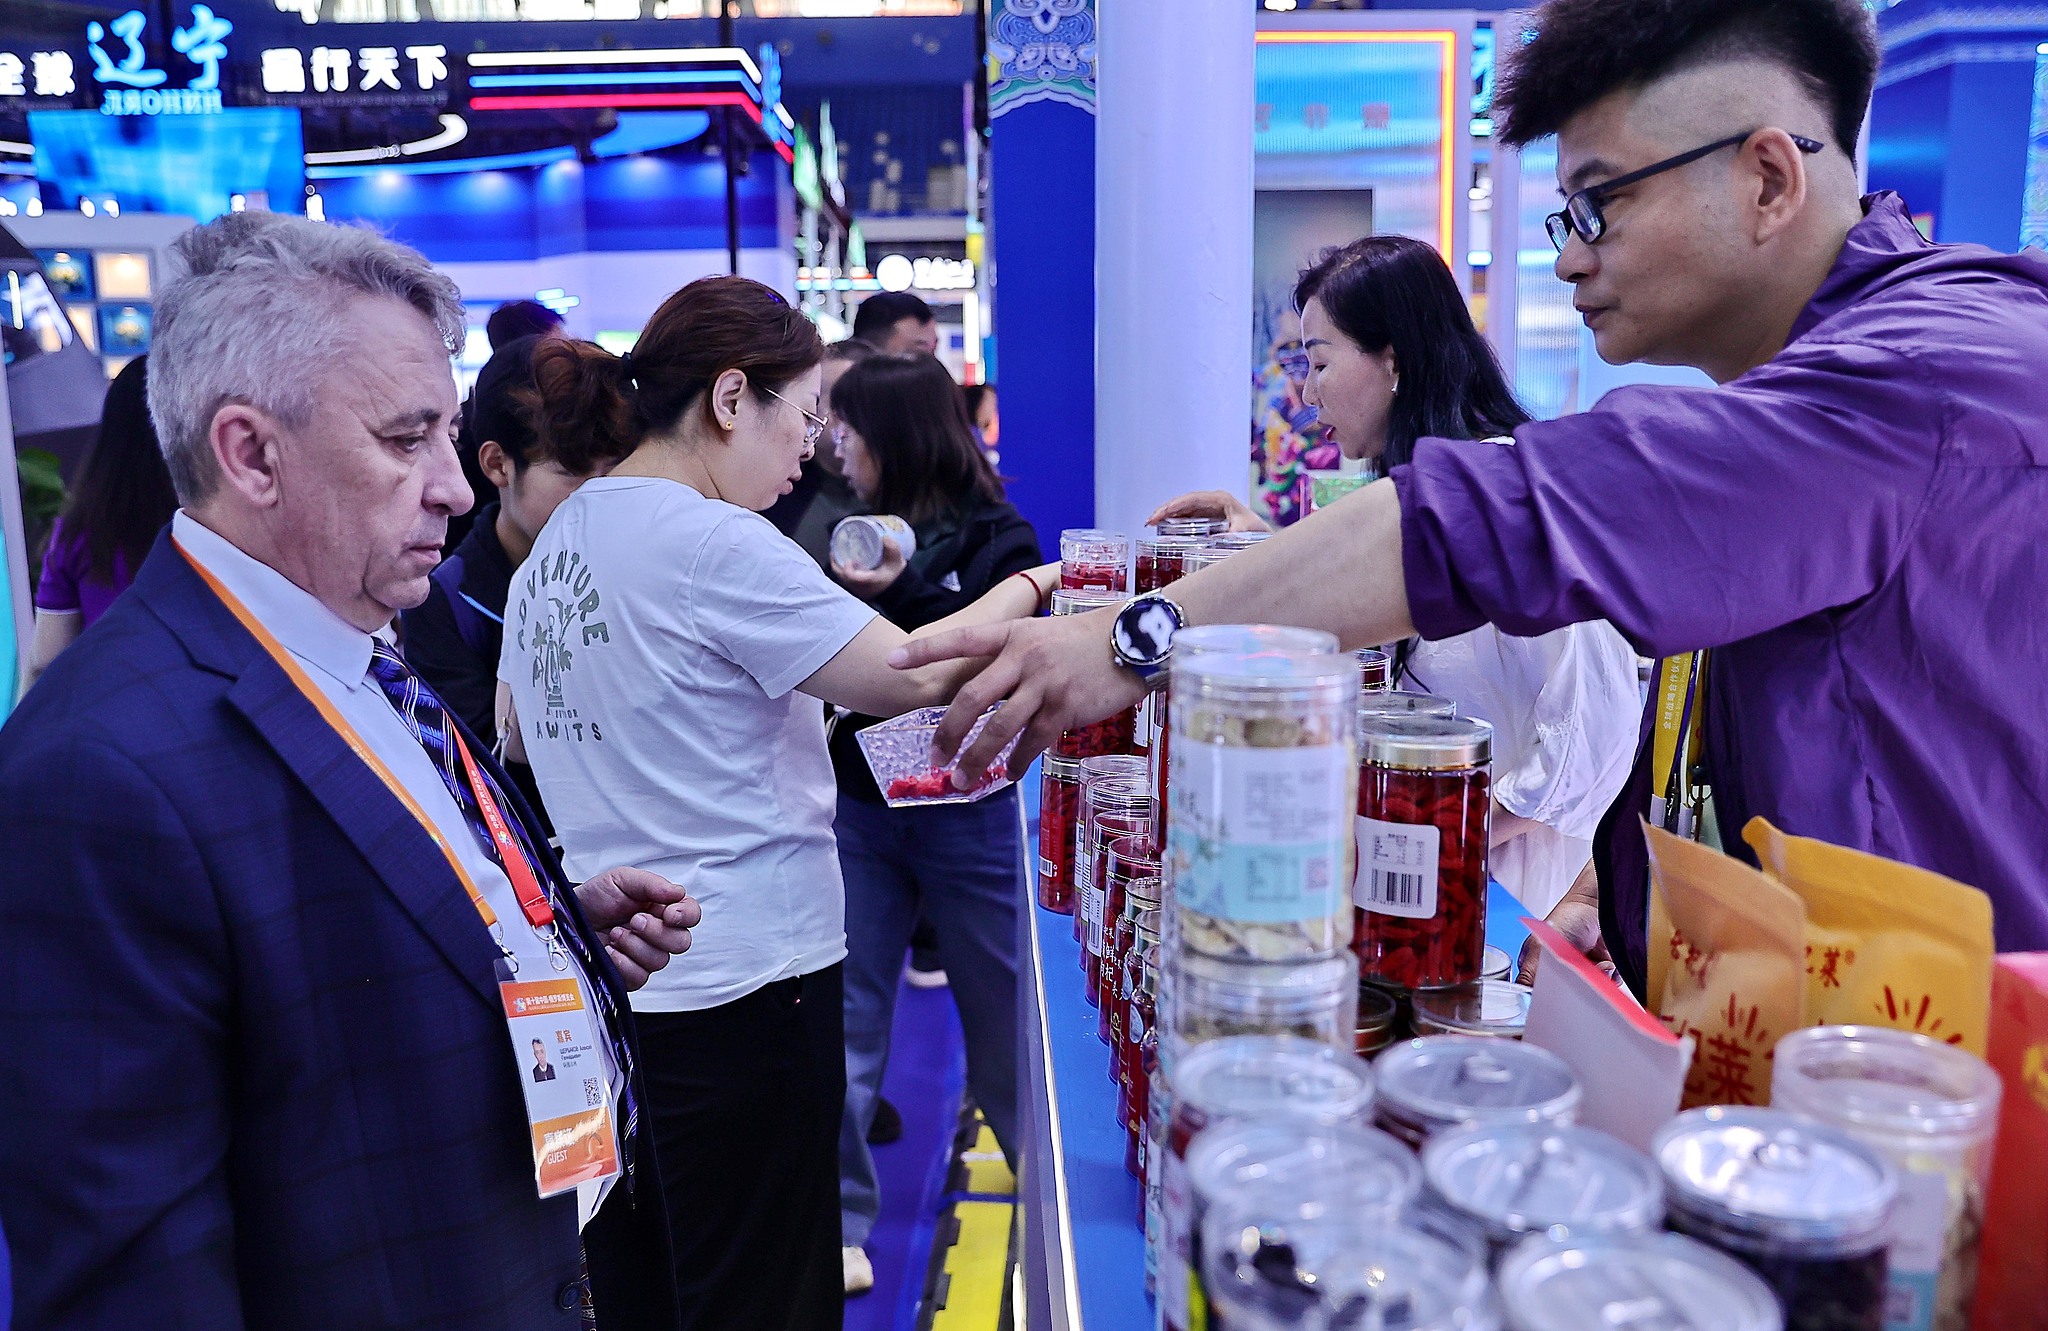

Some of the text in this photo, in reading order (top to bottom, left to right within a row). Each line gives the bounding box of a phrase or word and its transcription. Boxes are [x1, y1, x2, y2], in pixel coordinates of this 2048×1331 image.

[86, 3, 233, 88] 辽宁
[100, 88, 223, 116] ЛЯОНИН
[546, 1149, 568, 1164] GUEST
